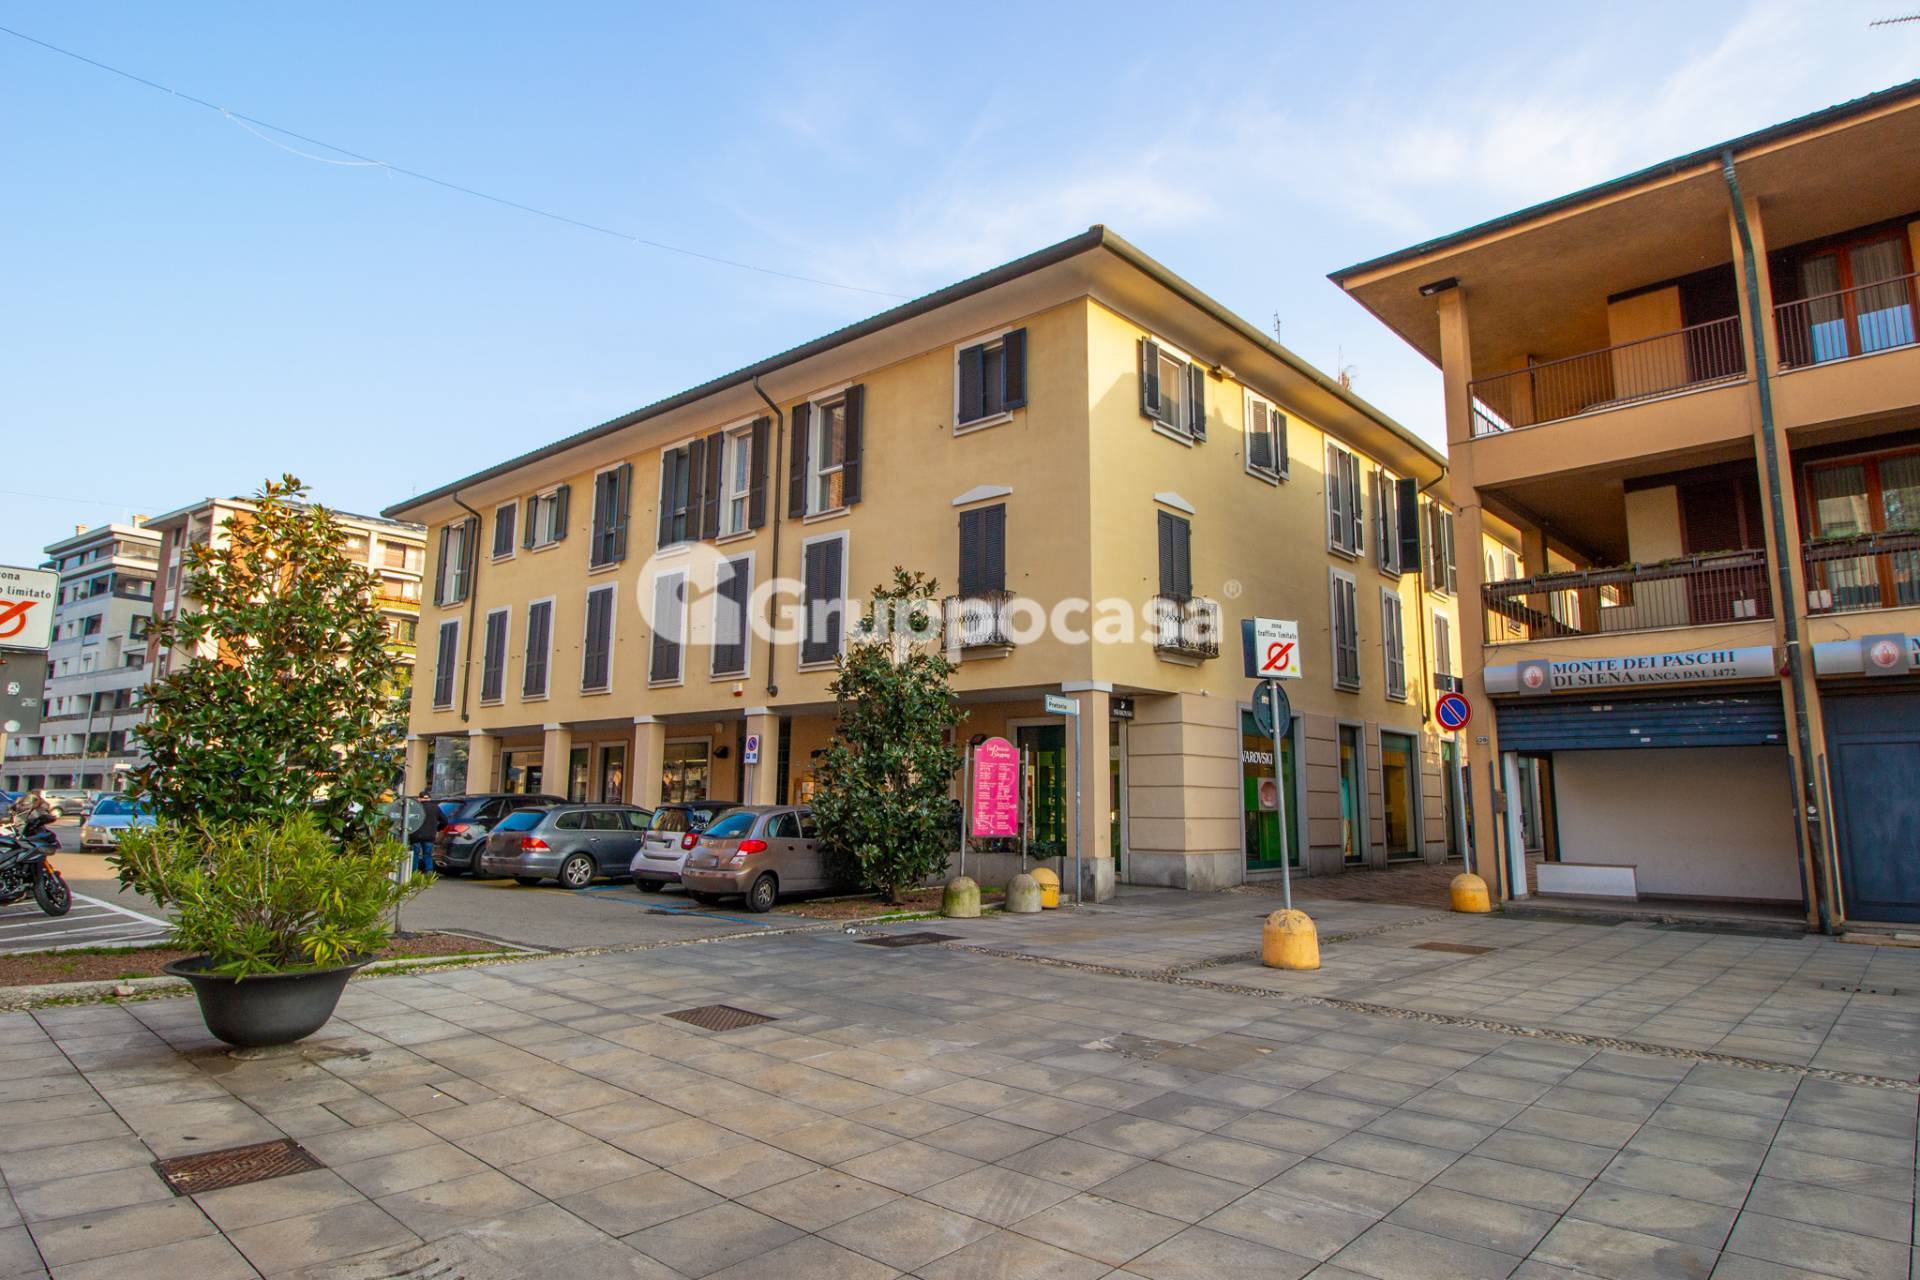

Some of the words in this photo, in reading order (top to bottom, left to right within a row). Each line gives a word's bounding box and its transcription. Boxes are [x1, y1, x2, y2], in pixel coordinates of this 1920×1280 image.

[0, 571, 20, 581] ona
[7, 585, 52, 599] limitato
[1553, 660, 1617, 674] MONTE
[1623, 656, 1656, 670] DEI
[1662, 650, 1736, 667] PASCHI
[1554, 674, 1573, 687] DI
[1578, 671, 1636, 686] SIENA
[1638, 672, 1680, 681] BANCA
[1683, 669, 1710, 679] DAL
[1713, 667, 1737, 677] 1472
[1242, 750, 1273, 765] AROVSKI
